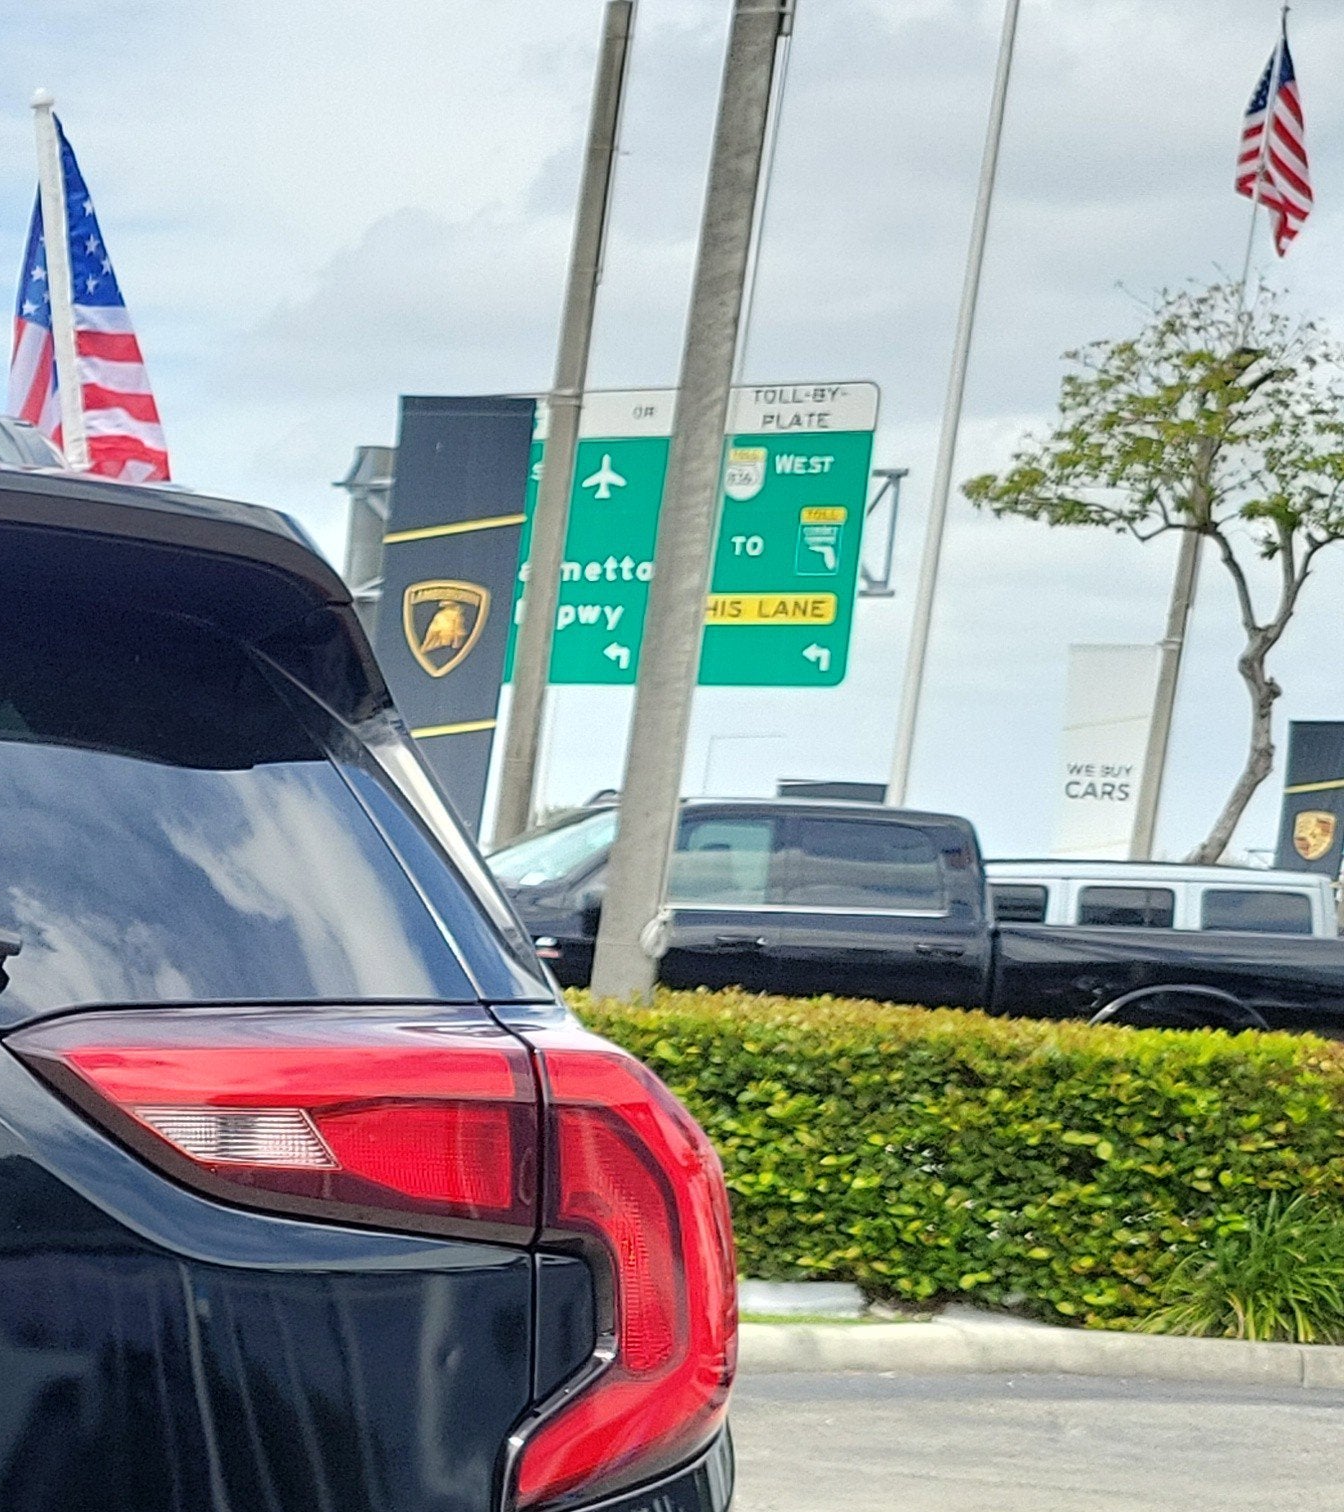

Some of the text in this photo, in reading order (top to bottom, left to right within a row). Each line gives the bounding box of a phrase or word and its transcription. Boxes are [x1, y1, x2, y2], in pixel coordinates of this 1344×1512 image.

[762, 412, 831, 430] PLATE
[775, 454, 835, 475] WEST
[730, 535, 764, 556] TO
[706, 600, 828, 619] HIS LANE
[1067, 763, 1095, 777] WE
[1064, 780, 1131, 801] CARS
